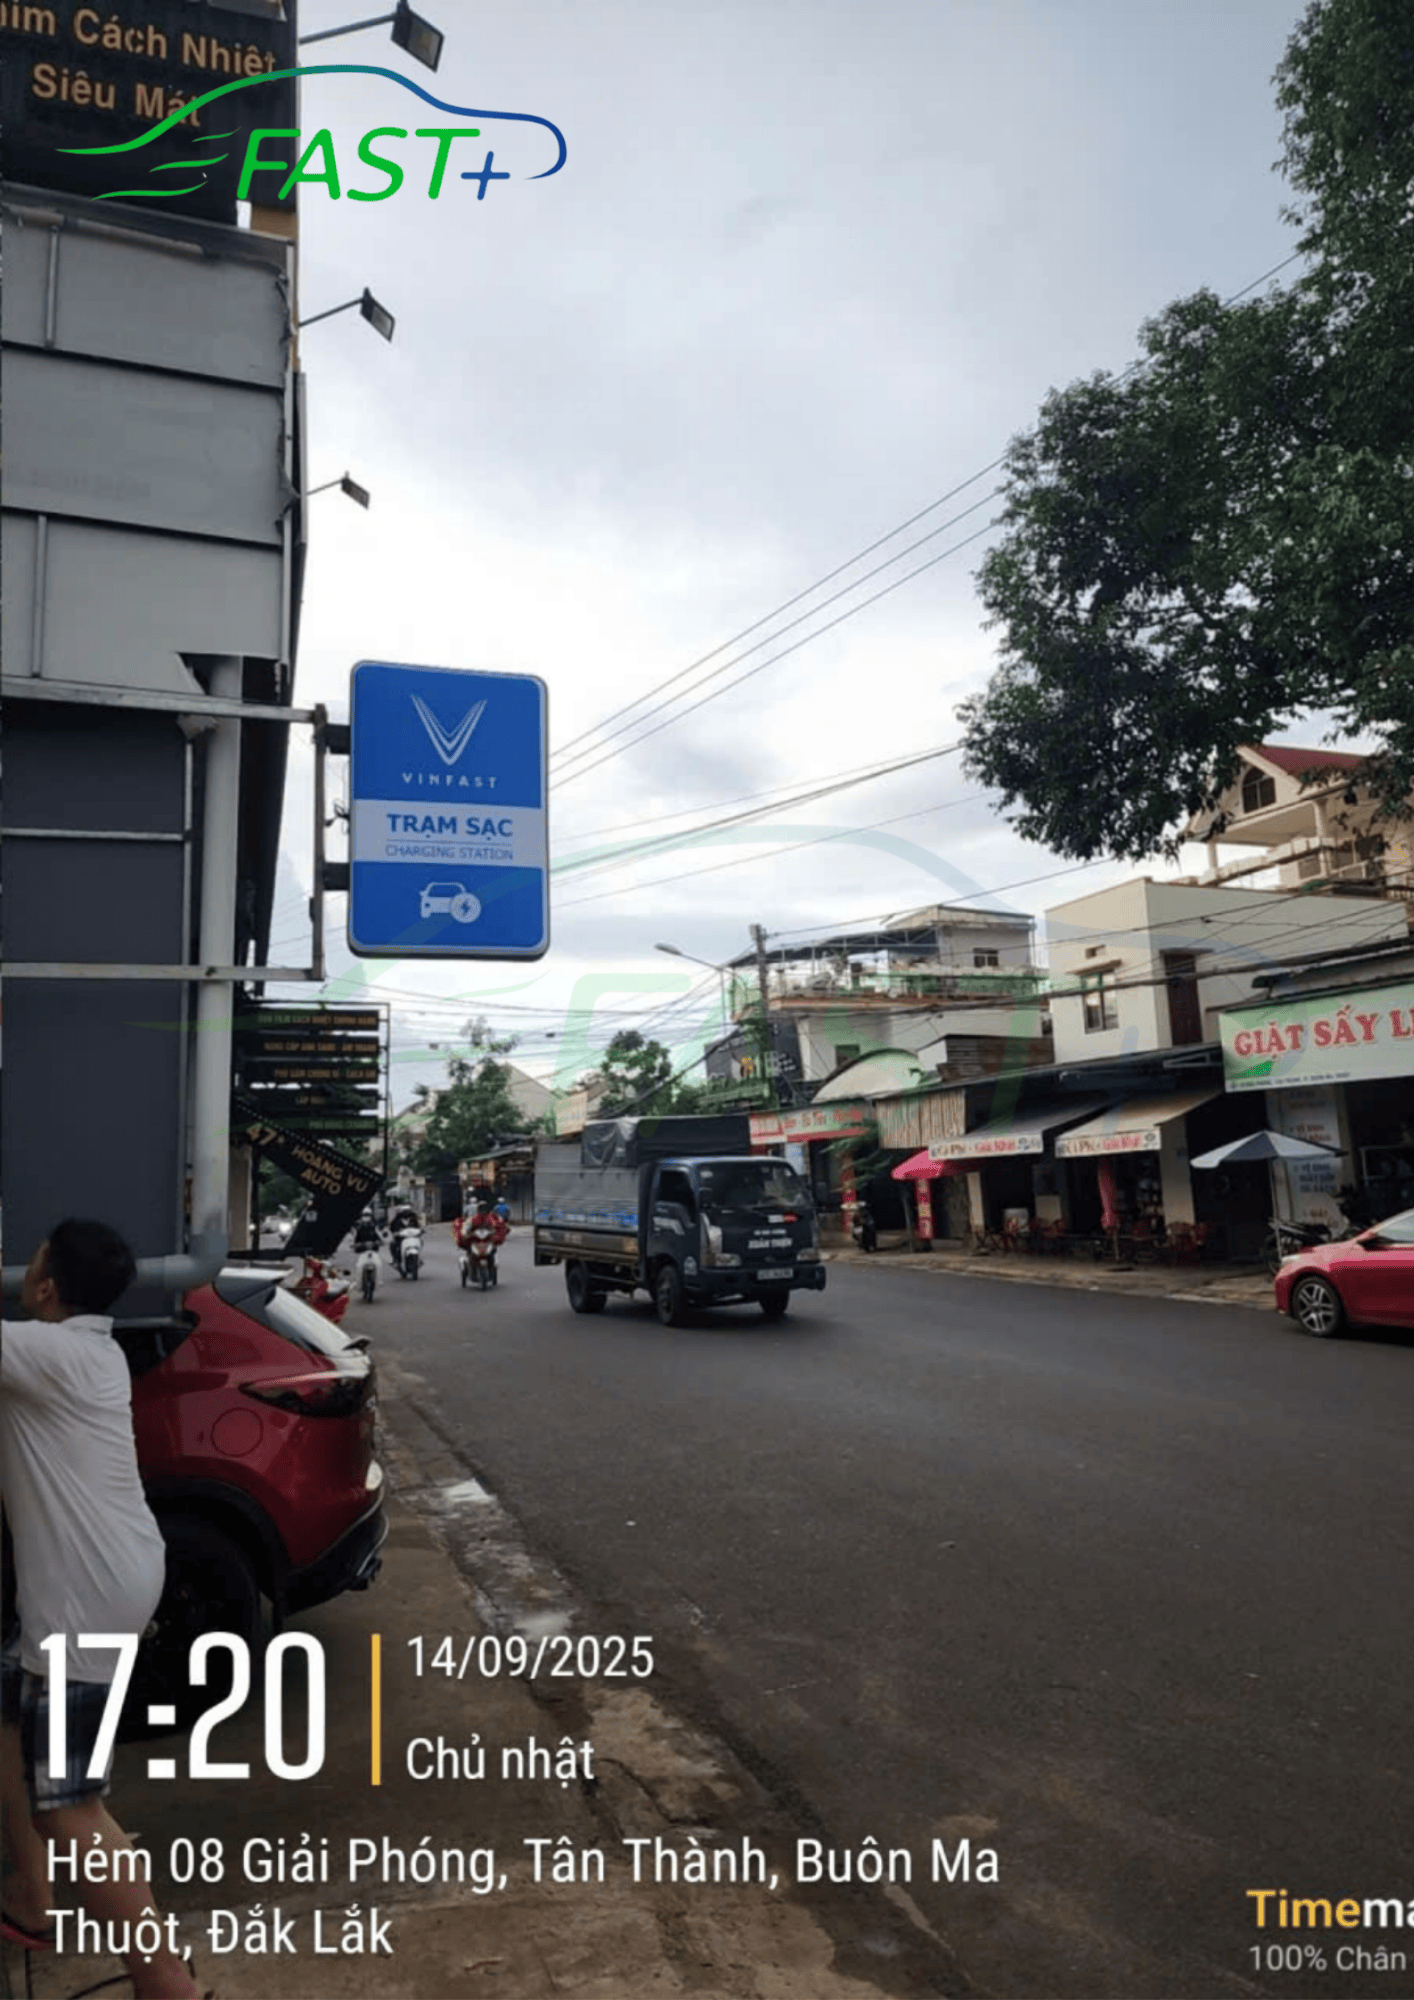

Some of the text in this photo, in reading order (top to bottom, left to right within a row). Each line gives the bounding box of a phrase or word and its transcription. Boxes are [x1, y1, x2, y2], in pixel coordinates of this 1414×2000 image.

[73, 8, 168, 60] Cách
[32, 62, 117, 110] Siêu
[401, 771, 497, 789] VINFAST
[386, 812, 513, 841] TRẠM SẠC
[384, 843, 513, 861] CHARGING STATION
[1234, 1003, 1414, 1060] GIẶT SẤY L
[300, 1167, 341, 1195] AUTO
